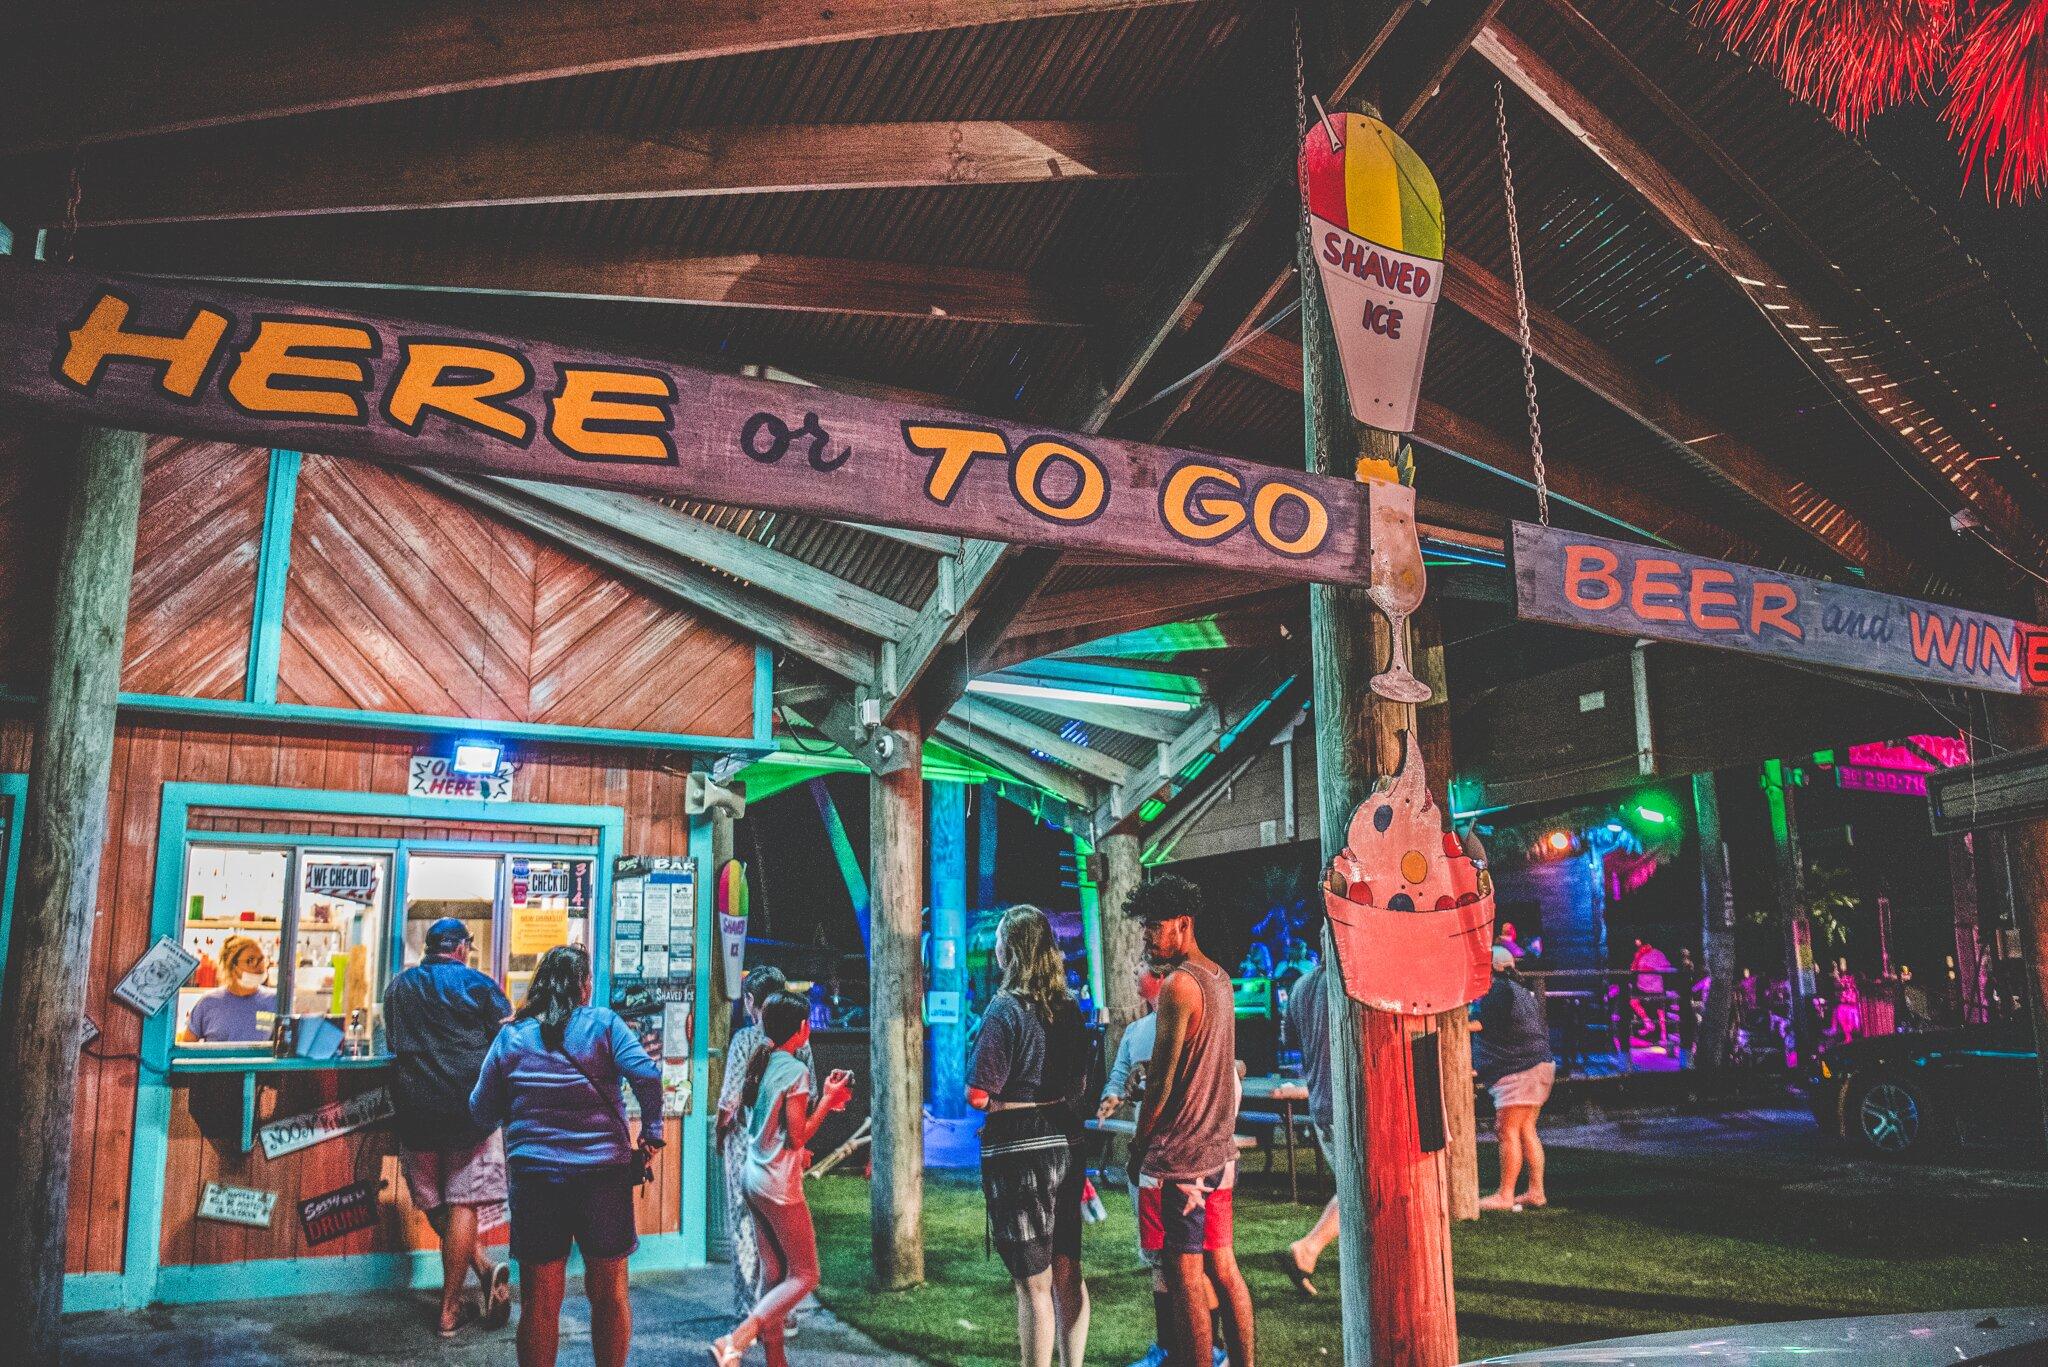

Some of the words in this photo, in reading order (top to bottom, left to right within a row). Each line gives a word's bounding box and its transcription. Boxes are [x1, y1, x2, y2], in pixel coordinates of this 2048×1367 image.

[1322, 231, 1432, 298] SHAVED
[1362, 300, 1404, 340] ICE
[51, 284, 680, 467] HERE
[740, 411, 851, 473] or
[901, 419, 1110, 527] TO
[1157, 456, 1336, 560] GO
[1561, 543, 1806, 642] BEER
[1821, 598, 1894, 644] and
[429, 779, 476, 796] HERE
[314, 868, 327, 887] WE
[329, 868, 358, 887] CHECK
[360, 869, 369, 887] ID
[654, 858, 696, 870] BAR
[532, 874, 558, 892] CHECK
[559, 874, 568, 892] ID
